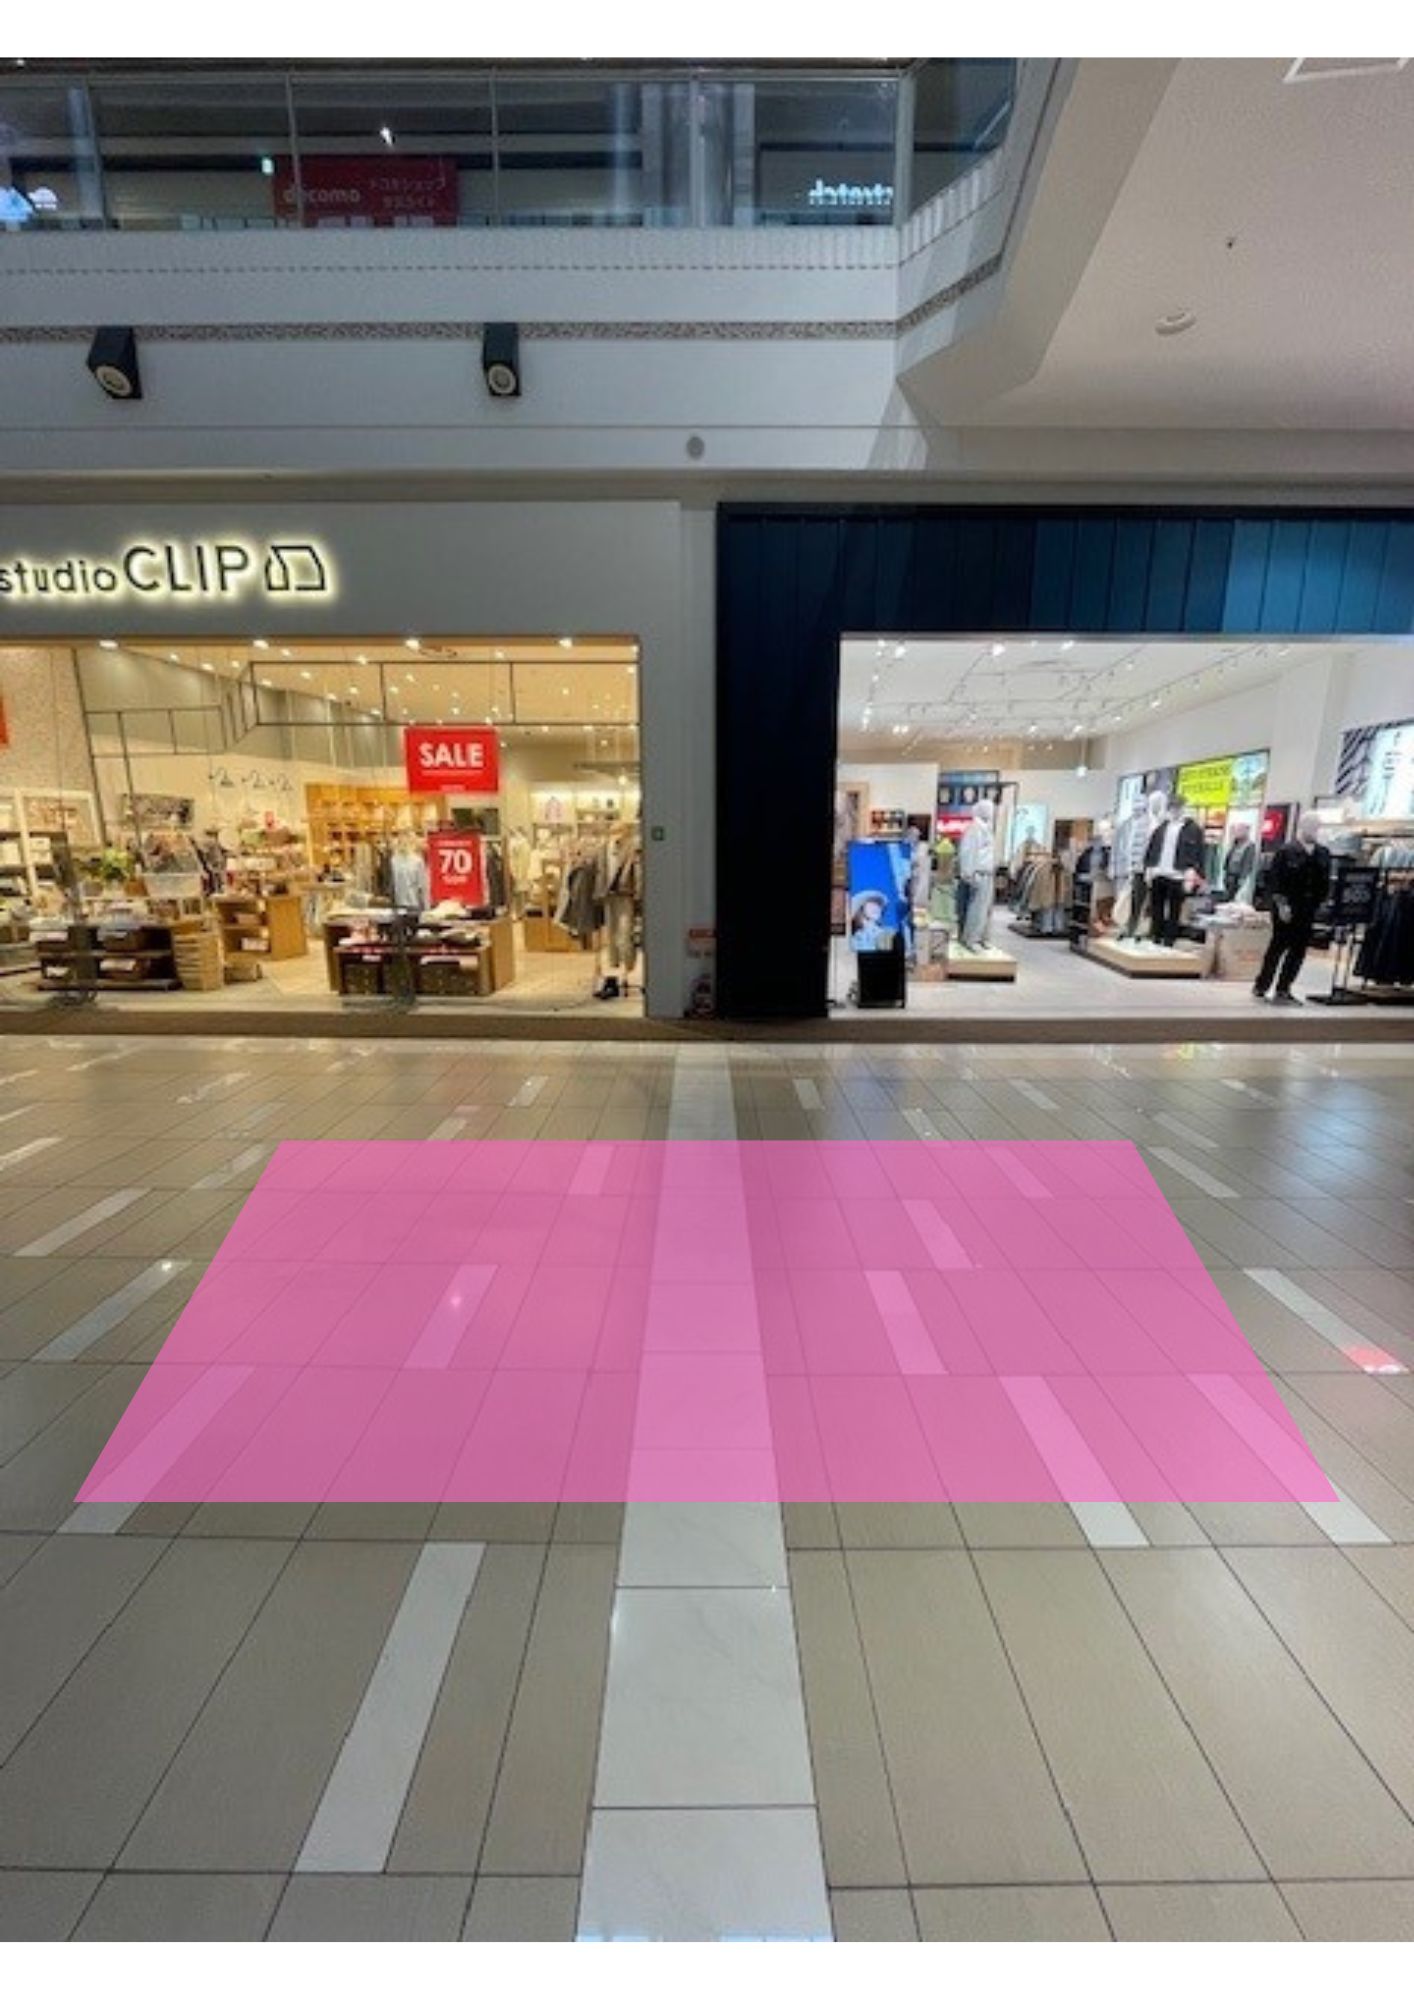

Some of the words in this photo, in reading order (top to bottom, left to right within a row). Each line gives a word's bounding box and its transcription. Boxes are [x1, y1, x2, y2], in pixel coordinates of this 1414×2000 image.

[0, 560, 117, 593] studio
[123, 545, 250, 592] CLIP
[419, 743, 484, 768] SALE
[438, 849, 473, 876] 70
